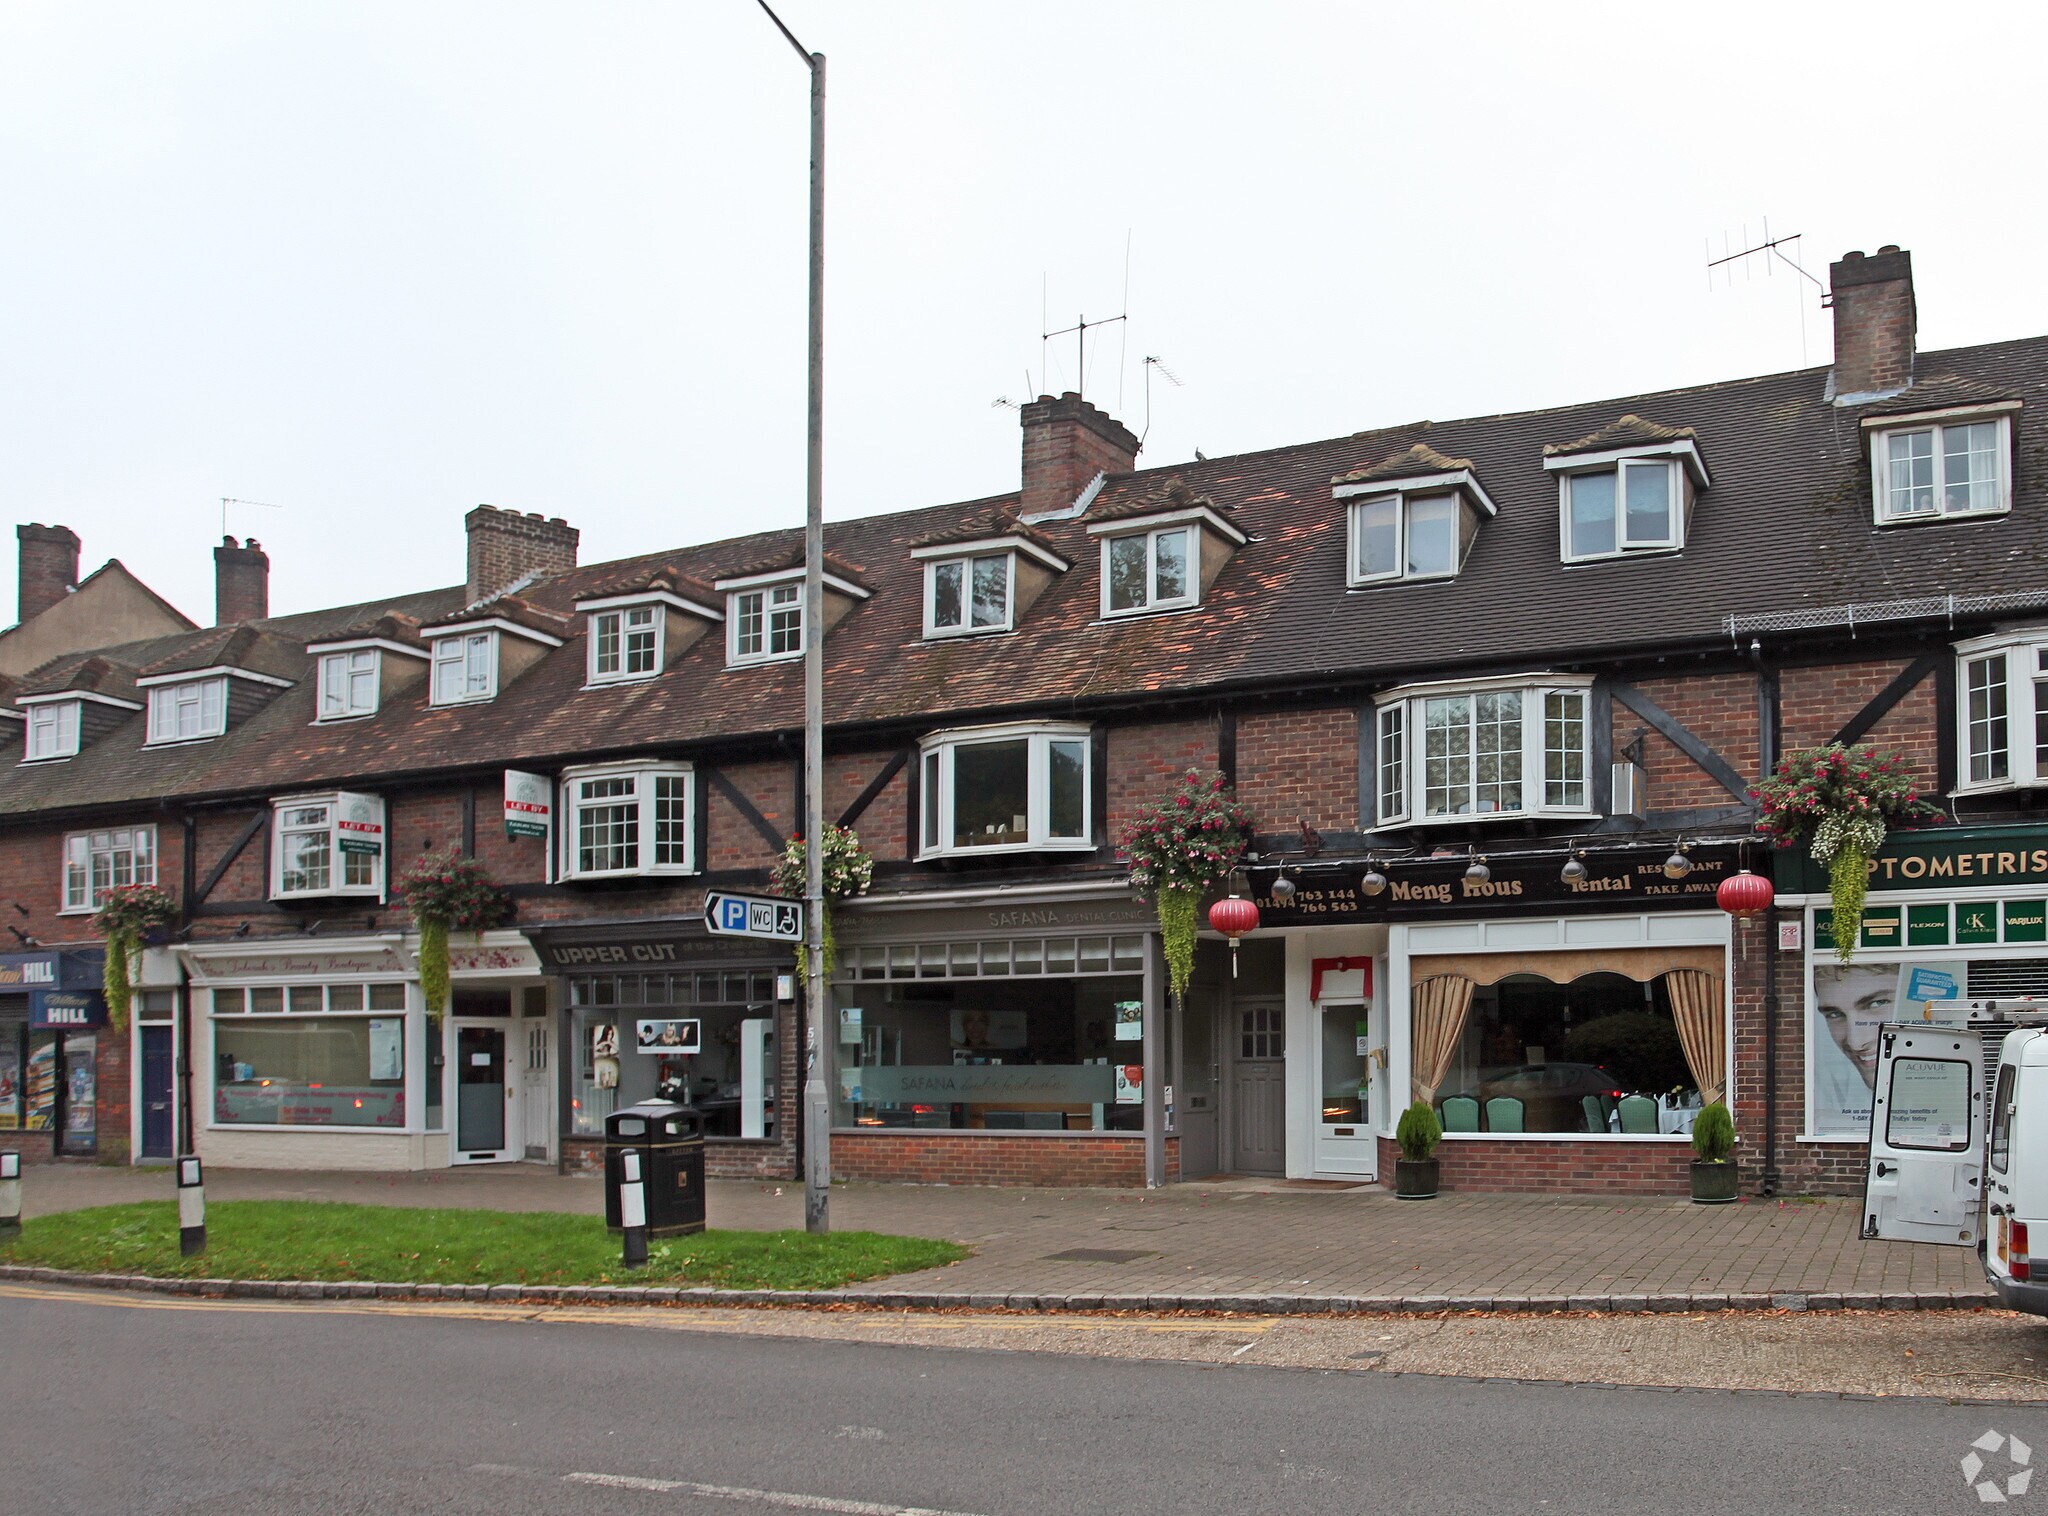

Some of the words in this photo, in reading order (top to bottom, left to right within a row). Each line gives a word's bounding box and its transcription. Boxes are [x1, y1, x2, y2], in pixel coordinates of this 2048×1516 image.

[511, 802, 527, 811] LET
[344, 822, 360, 830] LET
[1637, 861, 1723, 874] RESRANT
[1866, 850, 2048, 880] PTOMETRIS
[1296, 891, 1323, 901] 763
[1328, 889, 1355, 899] 144
[1389, 880, 1453, 904] Meng
[1645, 885, 1680, 895] TAKE
[1684, 883, 1718, 893] AWAY
[1299, 904, 1327, 913] 766
[1332, 902, 1358, 911] 563
[728, 902, 744, 928] P
[753, 909, 771, 926] WC
[988, 911, 1060, 927] SAFANA
[1066, 912, 1106, 923] DENTAL
[1109, 910, 1145, 921] CLINIC
[2006, 916, 2044, 926] VARILUX
[553, 947, 628, 964] UPPER
[633, 943, 676, 961] CUT
[282, 958, 319, 973] Beauty
[324, 955, 372, 972] Boutique
[23, 961, 54, 983] HILL
[47, 1008, 88, 1023] HILL
[1906, 1063, 1946, 1071] ACUVUE
[901, 1077, 956, 1091] SAFANA
